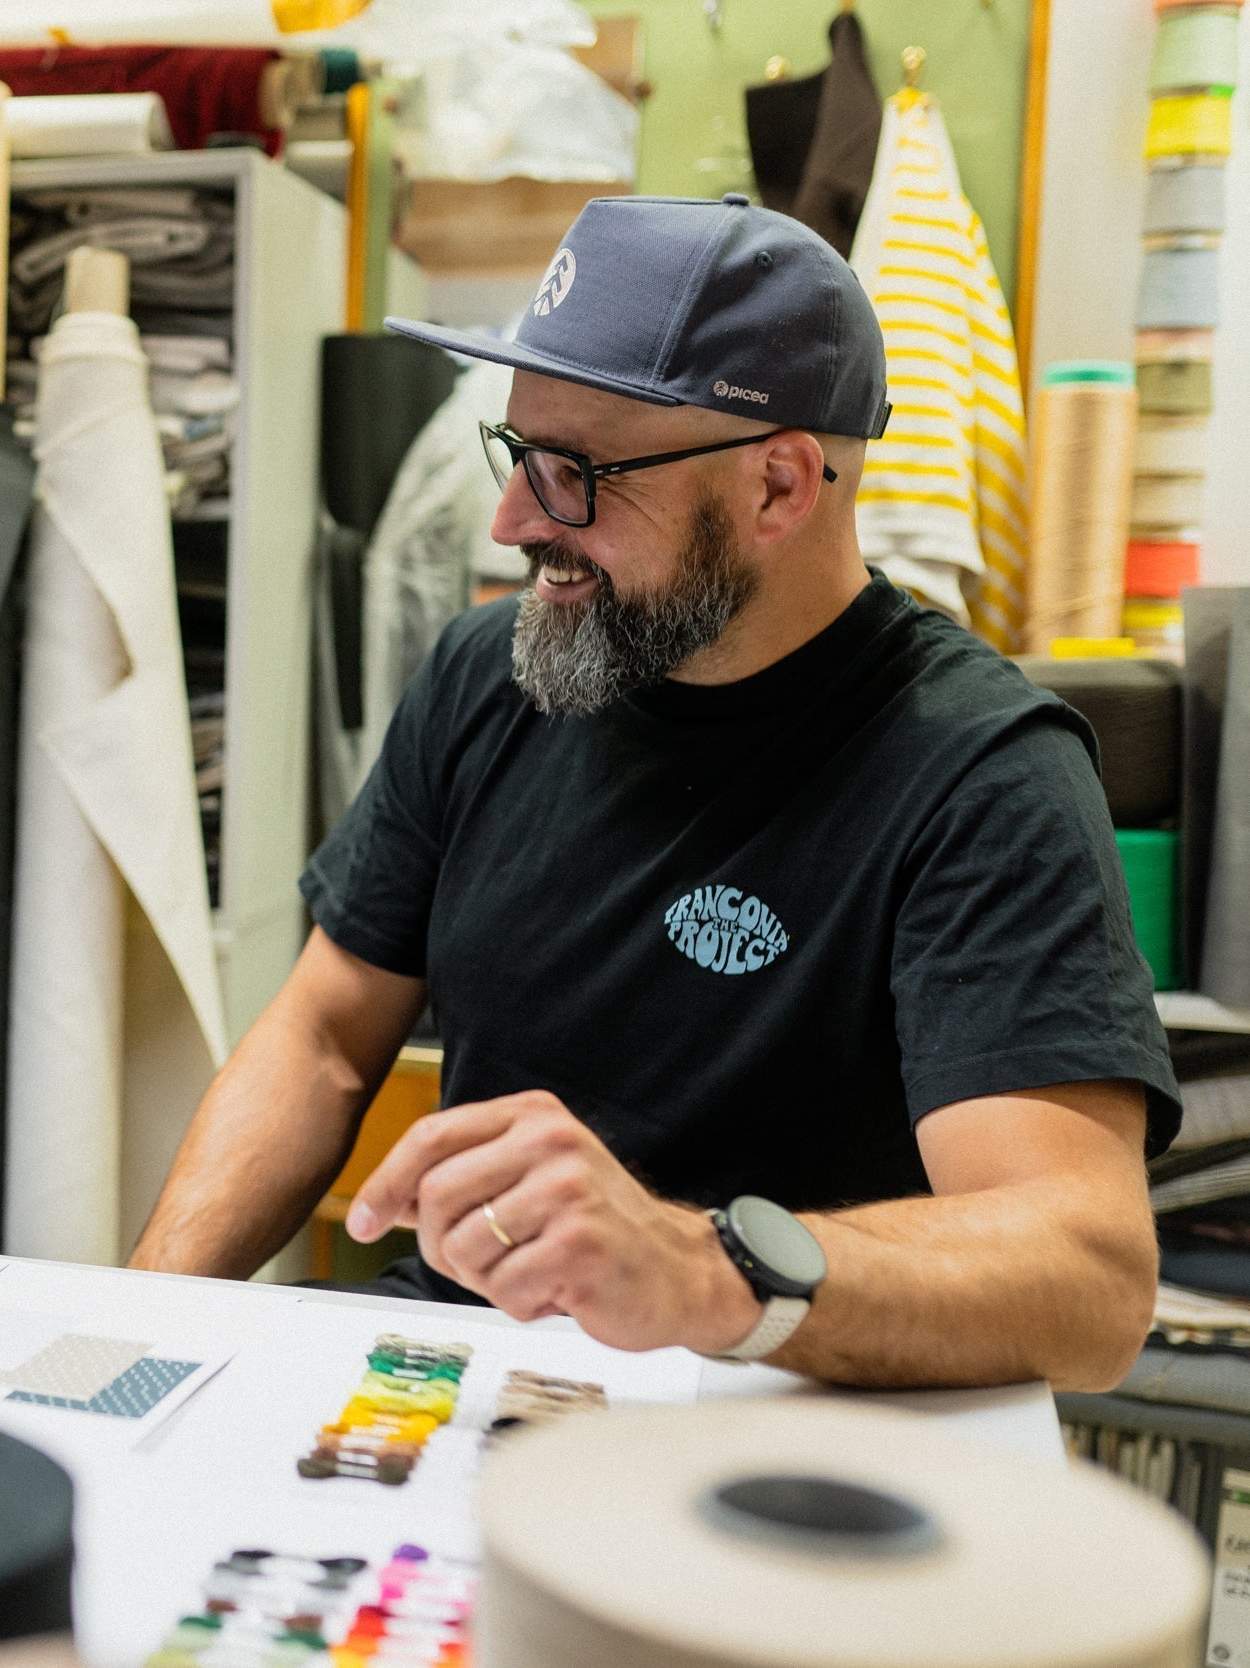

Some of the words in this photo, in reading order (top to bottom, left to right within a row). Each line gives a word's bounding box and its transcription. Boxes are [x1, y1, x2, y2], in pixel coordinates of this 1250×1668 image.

[728, 386, 769, 404] picea
[664, 885, 787, 952] FRANCONIA
[712, 918, 739, 933] THE
[668, 921, 779, 974] PROJECT
